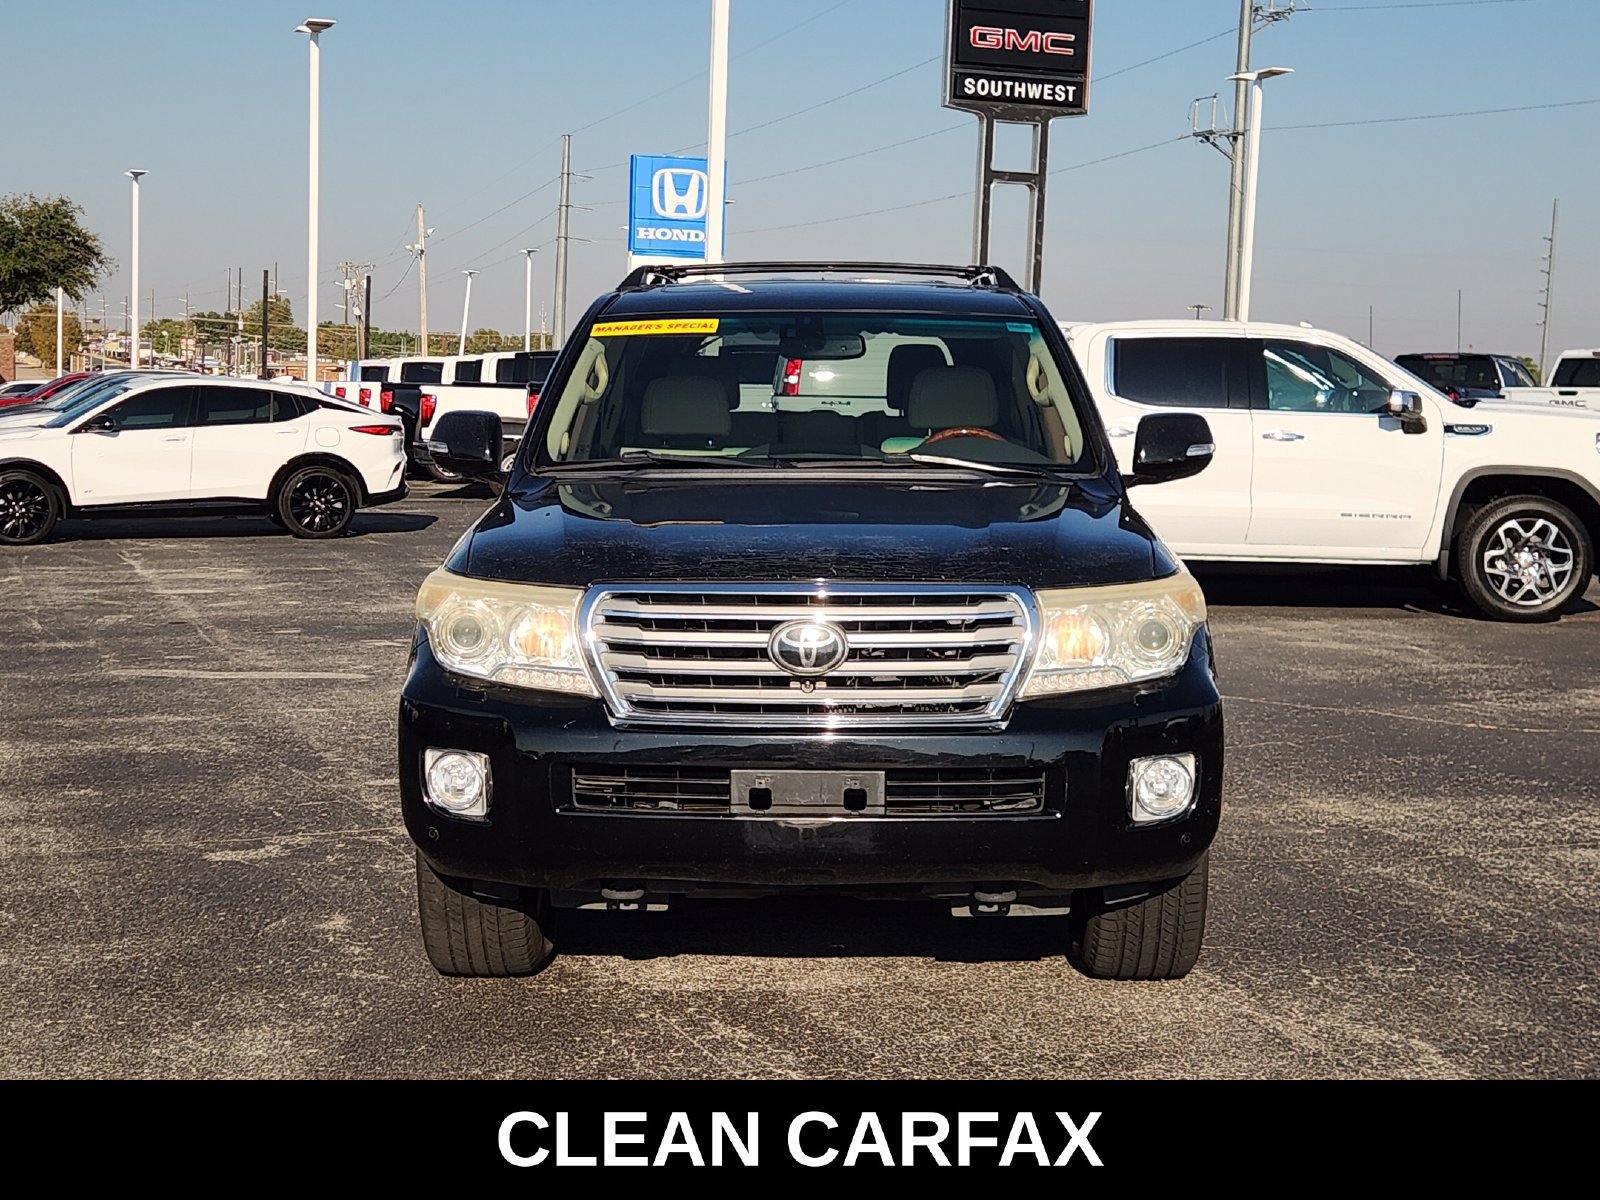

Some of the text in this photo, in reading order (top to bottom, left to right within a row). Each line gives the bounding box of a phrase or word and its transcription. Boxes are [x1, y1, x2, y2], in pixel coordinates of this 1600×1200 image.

[969, 25, 1076, 55] GMC
[964, 77, 1077, 102] SOUTHWEST
[636, 227, 706, 242] HOND
[594, 322, 715, 333] MANAGER'S SPECIAL
